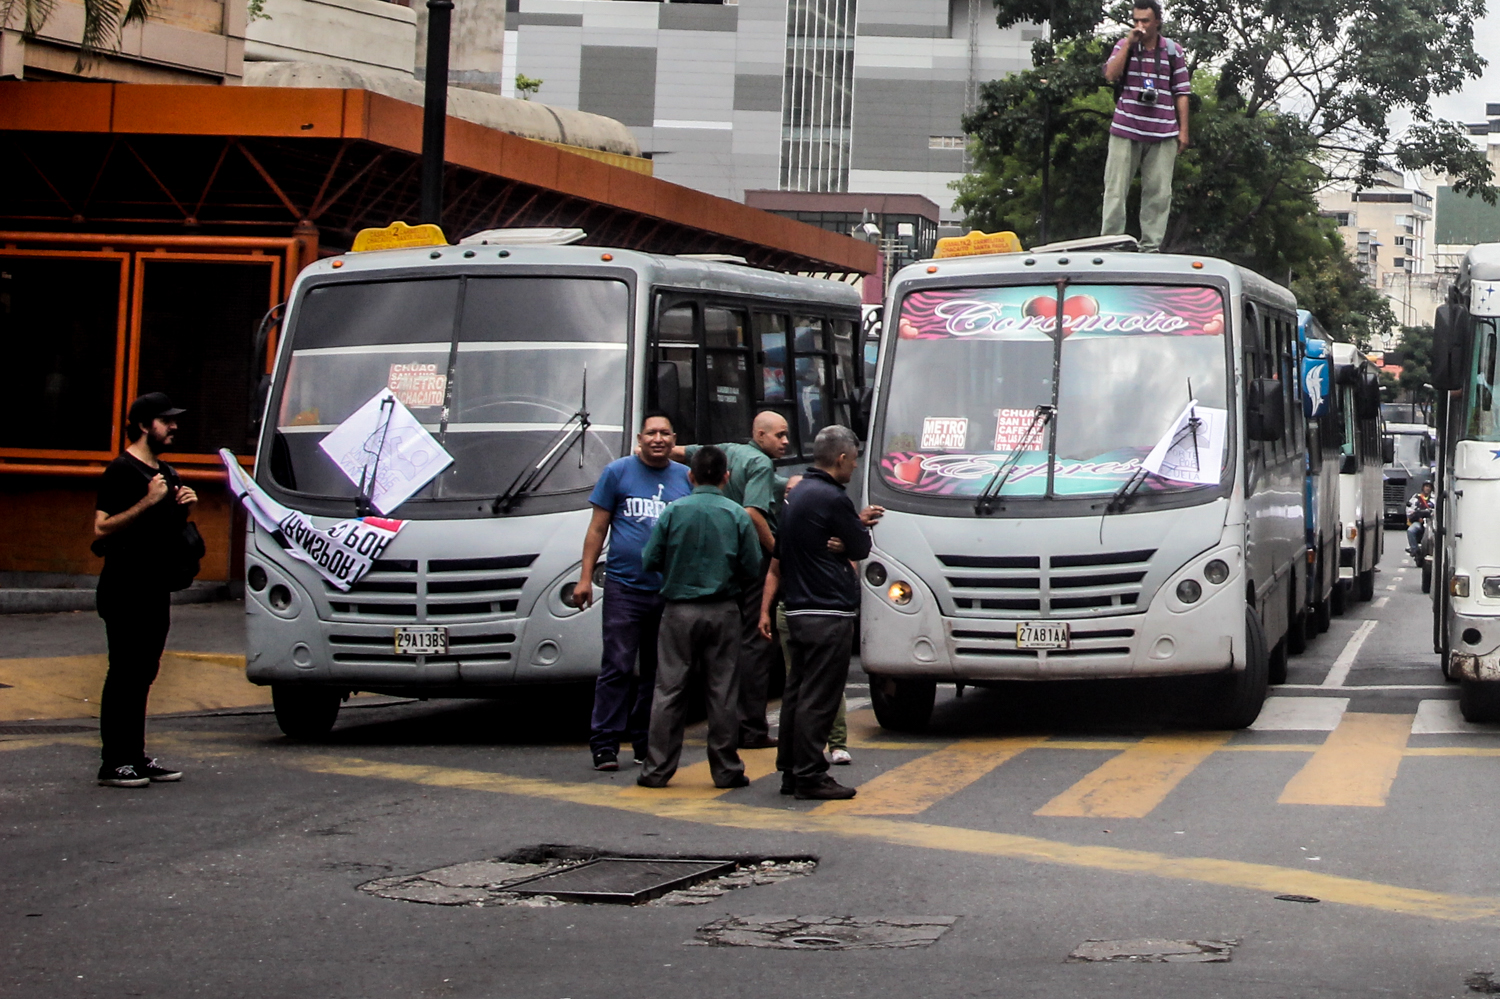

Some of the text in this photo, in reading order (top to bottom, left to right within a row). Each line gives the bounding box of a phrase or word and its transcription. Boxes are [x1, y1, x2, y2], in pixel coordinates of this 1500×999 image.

[392, 226, 399, 237] 2
[966, 238, 972, 246] 2
[935, 299, 1190, 337] Coromoto
[393, 364, 436, 372] CHUAO
[400, 376, 445, 390] METRO
[401, 390, 444, 405] CHACAITO
[925, 420, 966, 434] METRO
[999, 417, 1019, 426] SAN
[922, 434, 965, 447] CHACAITO
[623, 497, 672, 519] JORD
[397, 633, 446, 648] 29A13BS
[1019, 627, 1067, 642] 27A81AA
